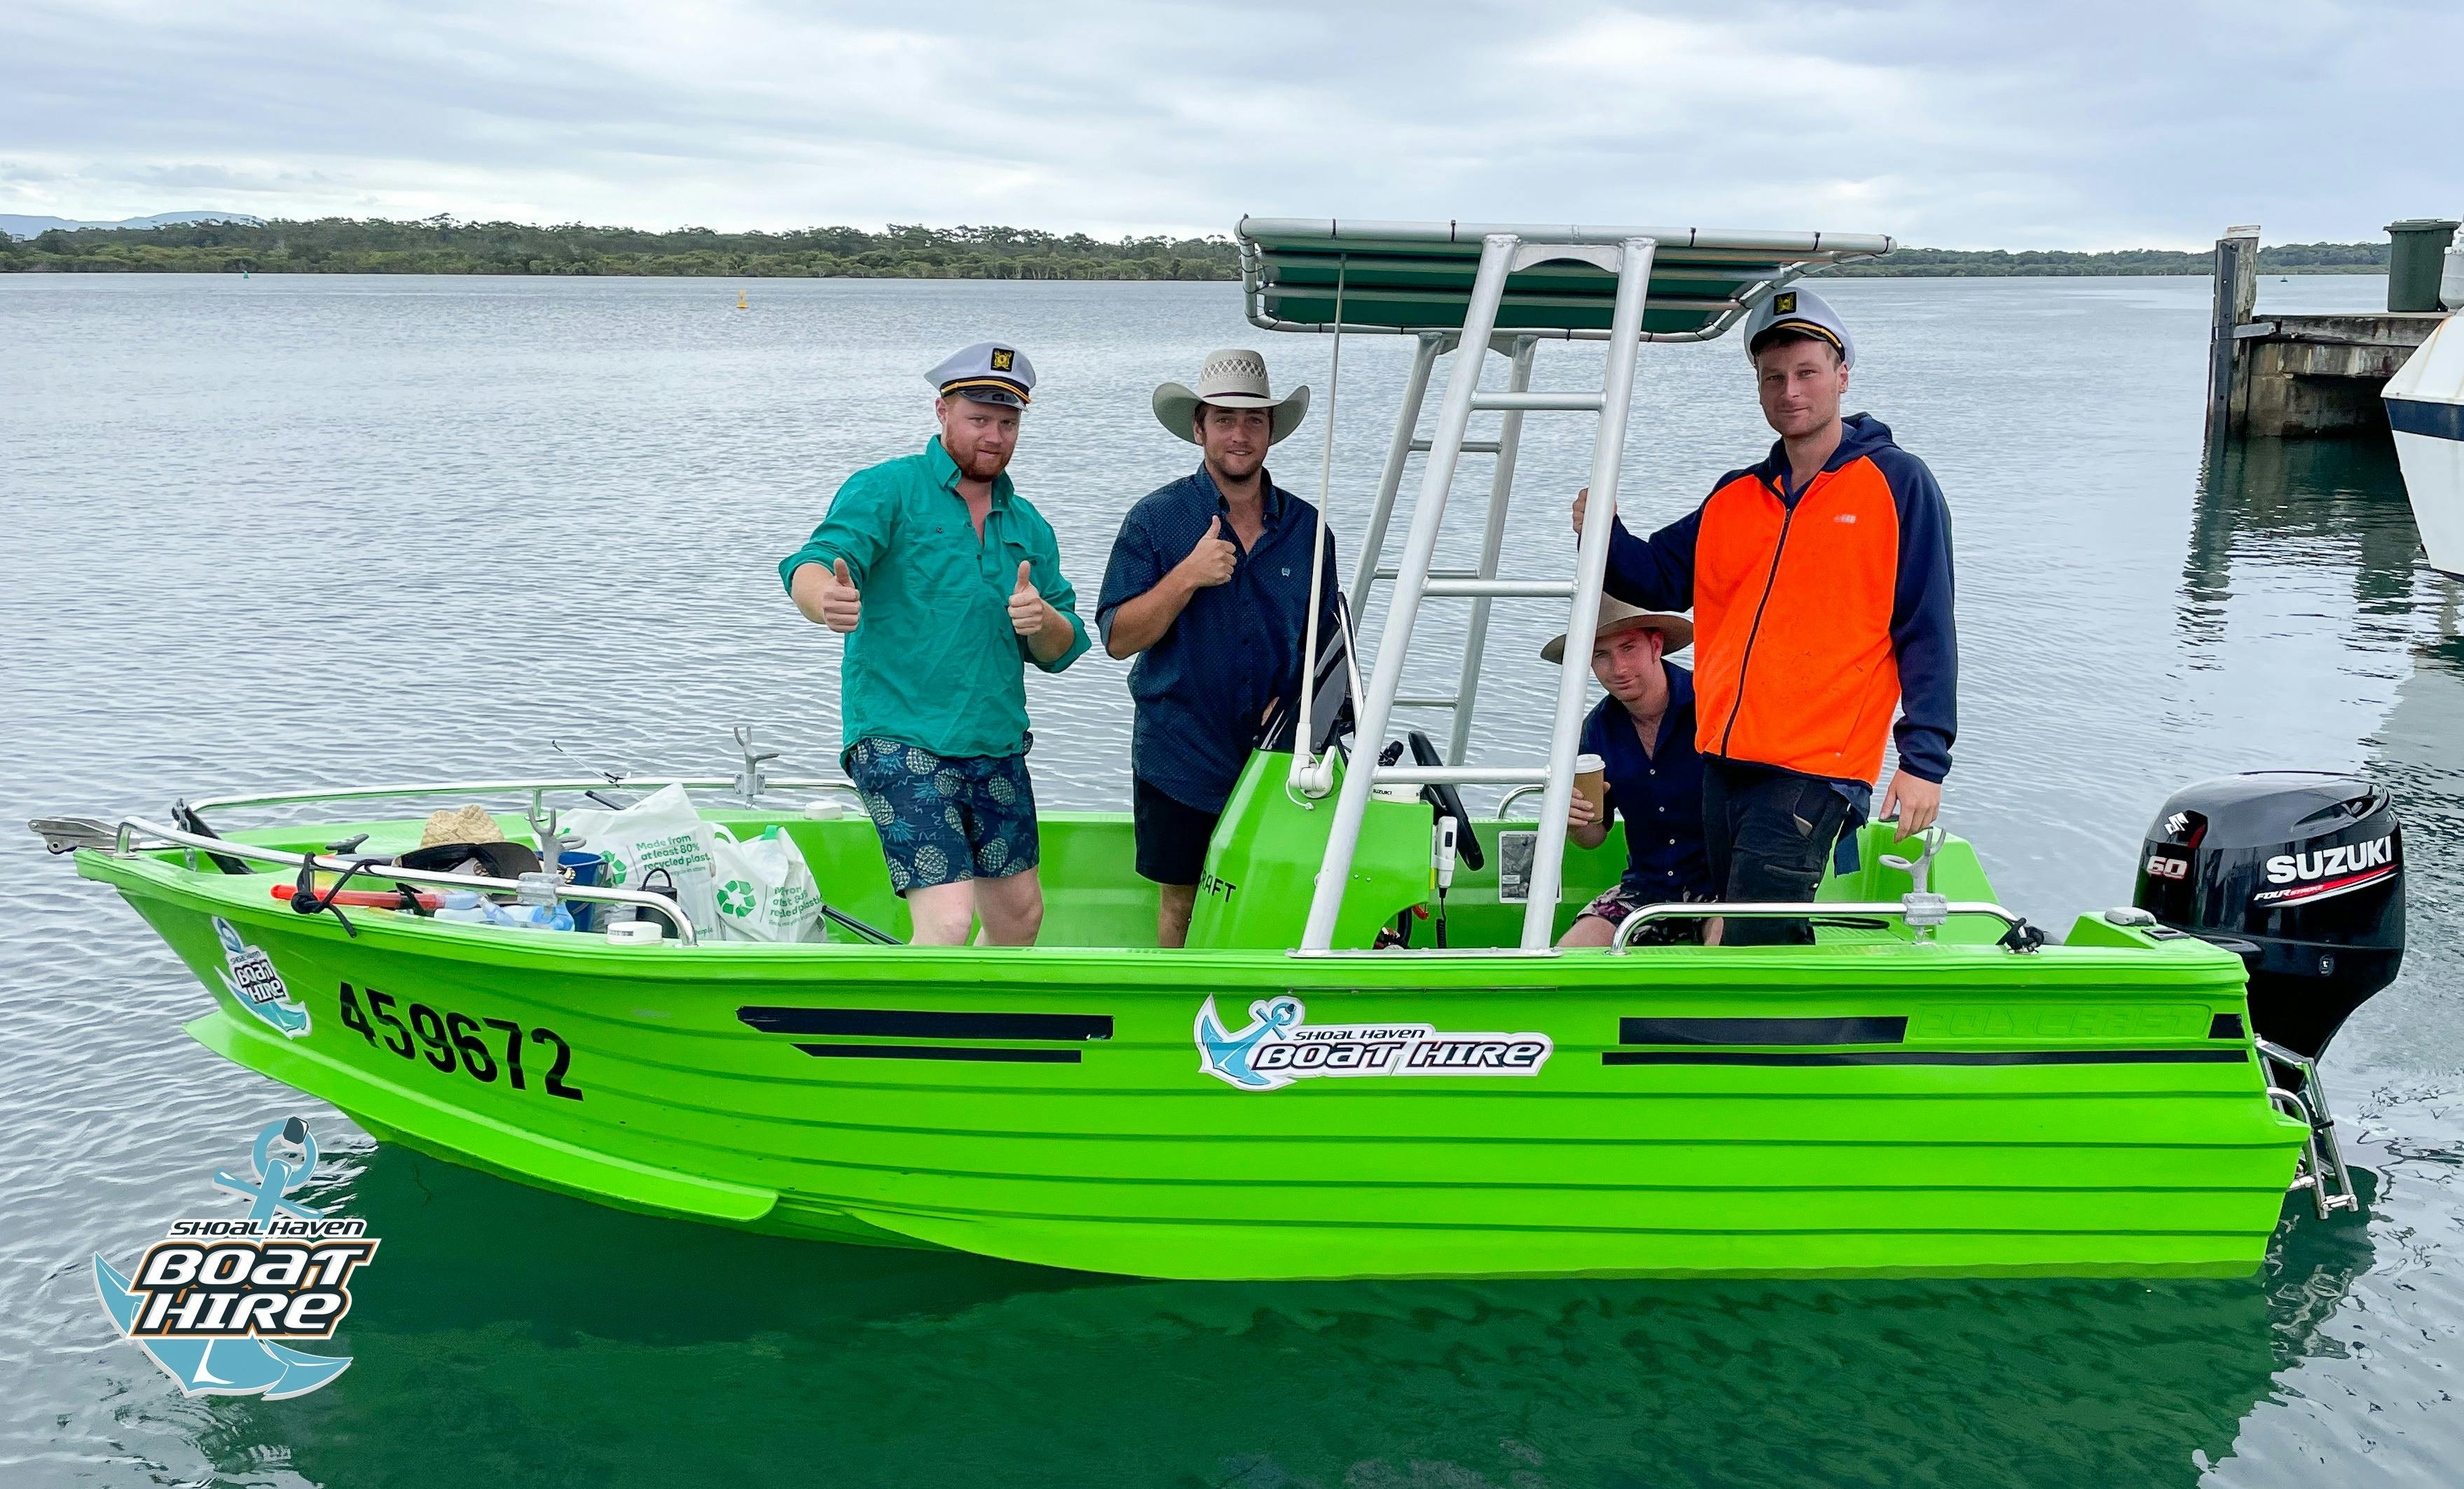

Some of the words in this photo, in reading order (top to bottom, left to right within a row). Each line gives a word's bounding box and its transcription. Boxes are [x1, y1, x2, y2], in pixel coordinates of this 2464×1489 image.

[636, 840, 666, 851] Made
[667, 835, 691, 846] from
[641, 851, 652, 861] at
[653, 846, 680, 858] least
[680, 842, 700, 854] 80%
[643, 856, 684, 871] recycled
[2146, 856, 2188, 880] 60
[2266, 835, 2392, 884] SUZUKI
[339, 980, 584, 1102] 459672
